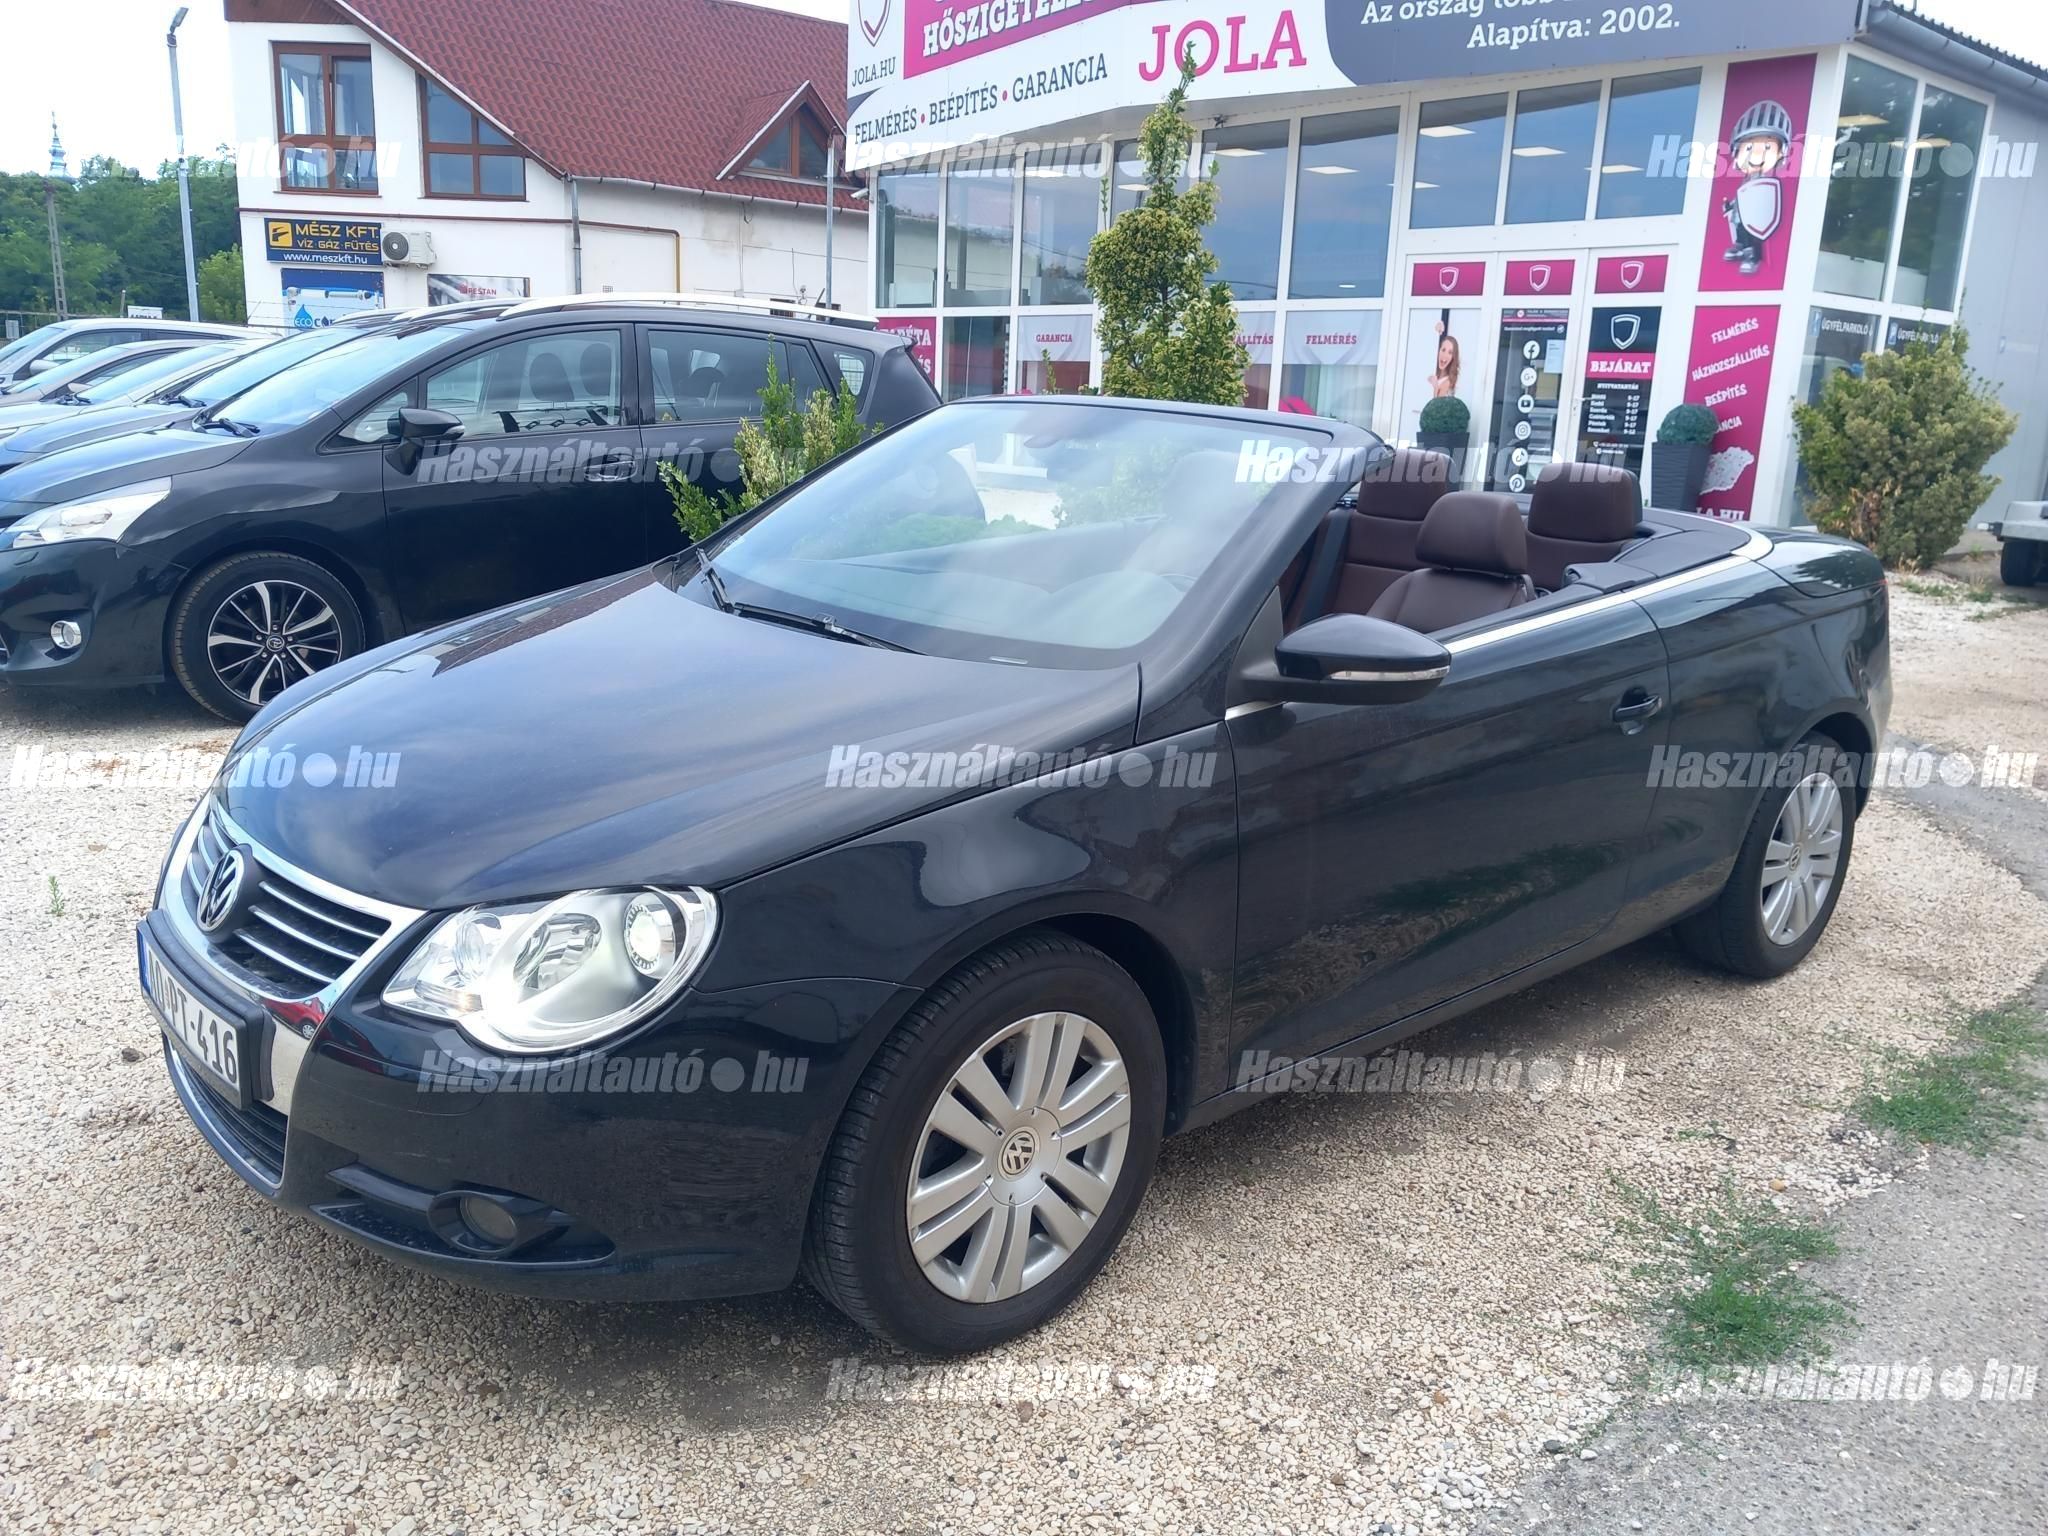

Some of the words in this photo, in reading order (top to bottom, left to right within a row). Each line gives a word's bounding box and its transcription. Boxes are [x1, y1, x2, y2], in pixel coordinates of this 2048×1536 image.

[1360, 0, 1394, 25] Az
[1466, 17, 1591, 50] Alapítva:
[1599, 3, 1680, 35] 2002.
[1138, 9, 1308, 82] JOLA
[852, 56, 897, 88] JOLA.HU
[855, 105, 917, 145] FELMÉRÉS
[929, 82, 998, 126] BEÉPÍTÉS
[1012, 52, 1108, 103] GARANCIA
[295, 221, 341, 237] MÉSZ
[346, 226, 380, 239] KFT.
[297, 239, 314, 248] VÍZ
[318, 239, 340, 250] GÁZ
[283, 253, 368, 264] www.meszkft.hu
[1036, 333, 1072, 343] GARANCIA
[1305, 332, 1357, 345] FELMÉRÉS
[1711, 317, 1760, 344] FELMÉRÉS
[1590, 358, 1652, 374] BEJÁRAT
[1704, 383, 1748, 407] BEÉPÍTÉS
